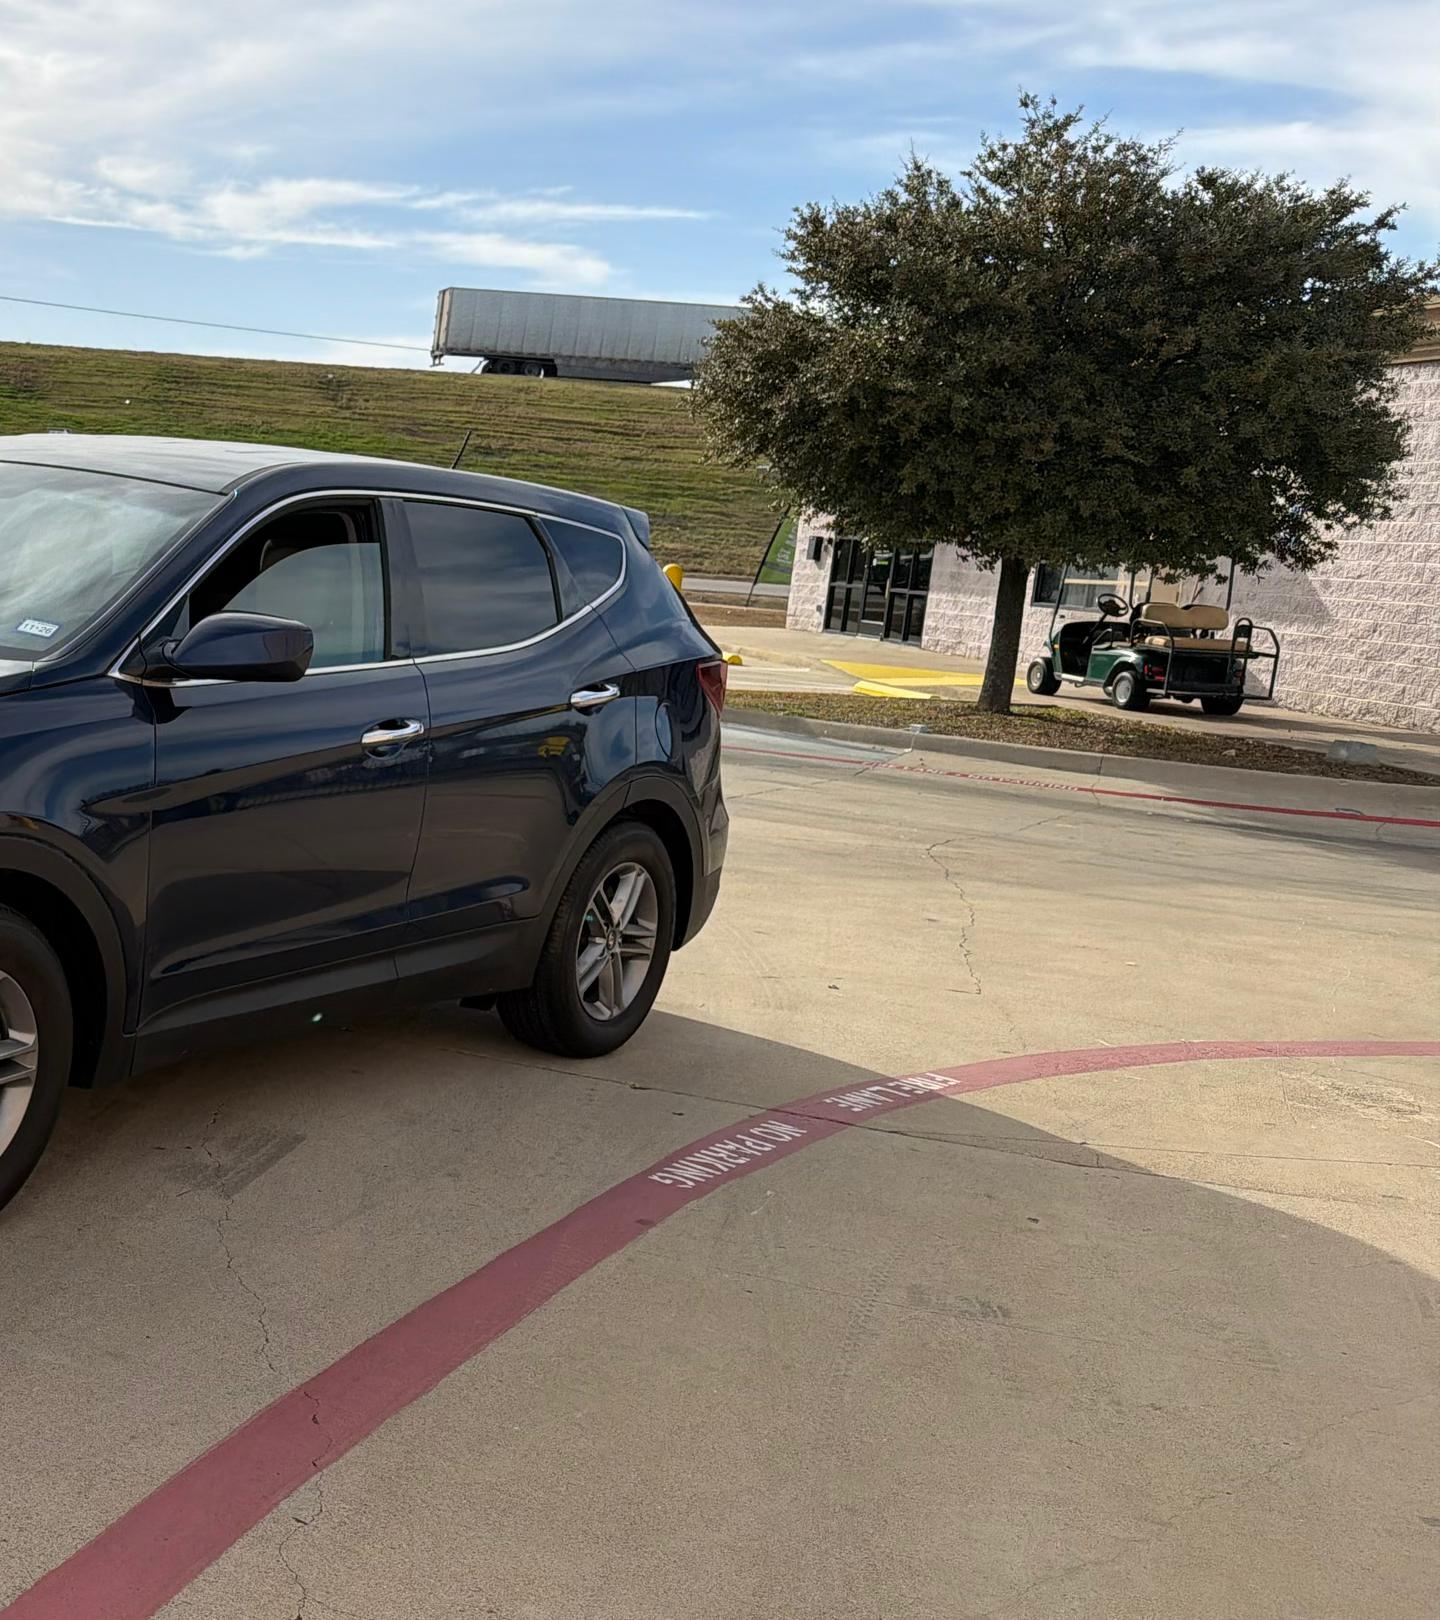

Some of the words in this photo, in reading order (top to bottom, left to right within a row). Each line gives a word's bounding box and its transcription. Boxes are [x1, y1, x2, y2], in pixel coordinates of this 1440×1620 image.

[886, 1071, 961, 1095] FIRE
[822, 1085, 912, 1112] LANE
[749, 1119, 808, 1142] NO
[647, 1134, 776, 1189] PARKING
